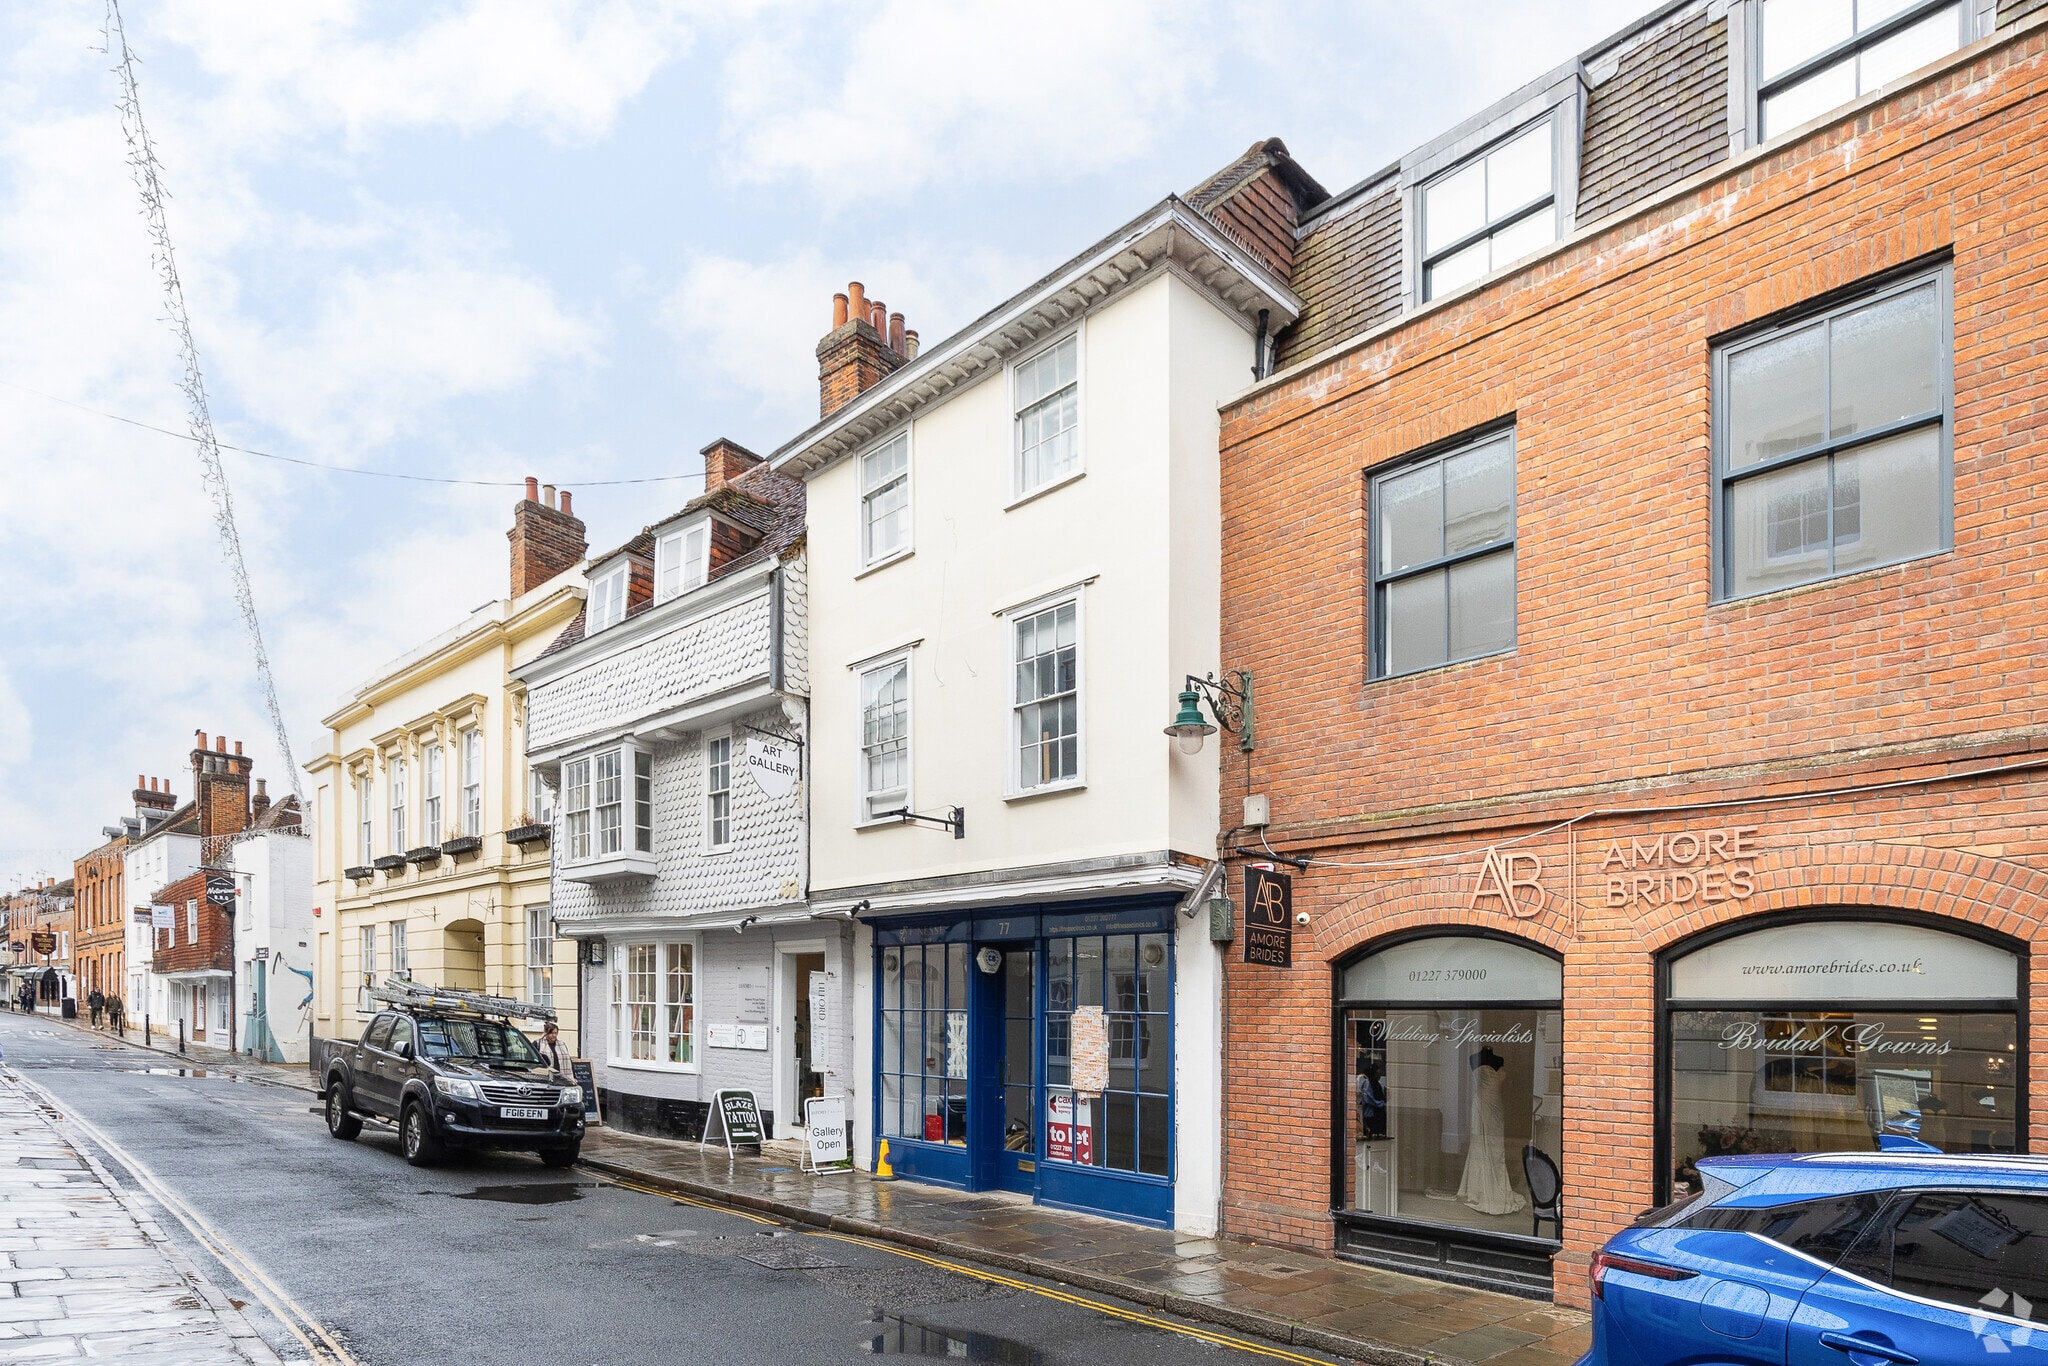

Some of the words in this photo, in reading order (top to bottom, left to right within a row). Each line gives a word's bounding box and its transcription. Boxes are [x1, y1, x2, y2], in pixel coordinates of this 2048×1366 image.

[762, 744, 782, 758] ART
[749, 755, 795, 776] GALLERY
[1601, 825, 1758, 870] AMORE
[1606, 866, 1756, 908] BRIDES
[998, 922, 1010, 935] 77
[1250, 932, 1286, 949] AMORE
[1250, 946, 1284, 963] BRIDES
[1408, 969, 1442, 982] 01227
[1444, 968, 1487, 981] 379000
[1742, 958, 1926, 976] www.amorebrides.co.uk
[818, 982, 826, 1021] LILFORD
[1369, 1016, 1440, 1048] Wedding
[1446, 1017, 1533, 1048] Specialists
[1717, 1021, 1838, 1051] Bridal
[1841, 1022, 1952, 1055] Gowns
[505, 1108, 525, 1117] FG16
[526, 1109, 543, 1118] EFN
[724, 1101, 754, 1111] BLAZE
[725, 1111, 757, 1123] TATTOO
[812, 1126, 844, 1138] Gallery
[1049, 1126, 1066, 1143] to
[1068, 1127, 1089, 1146] let
[816, 1139, 840, 1151] Open
